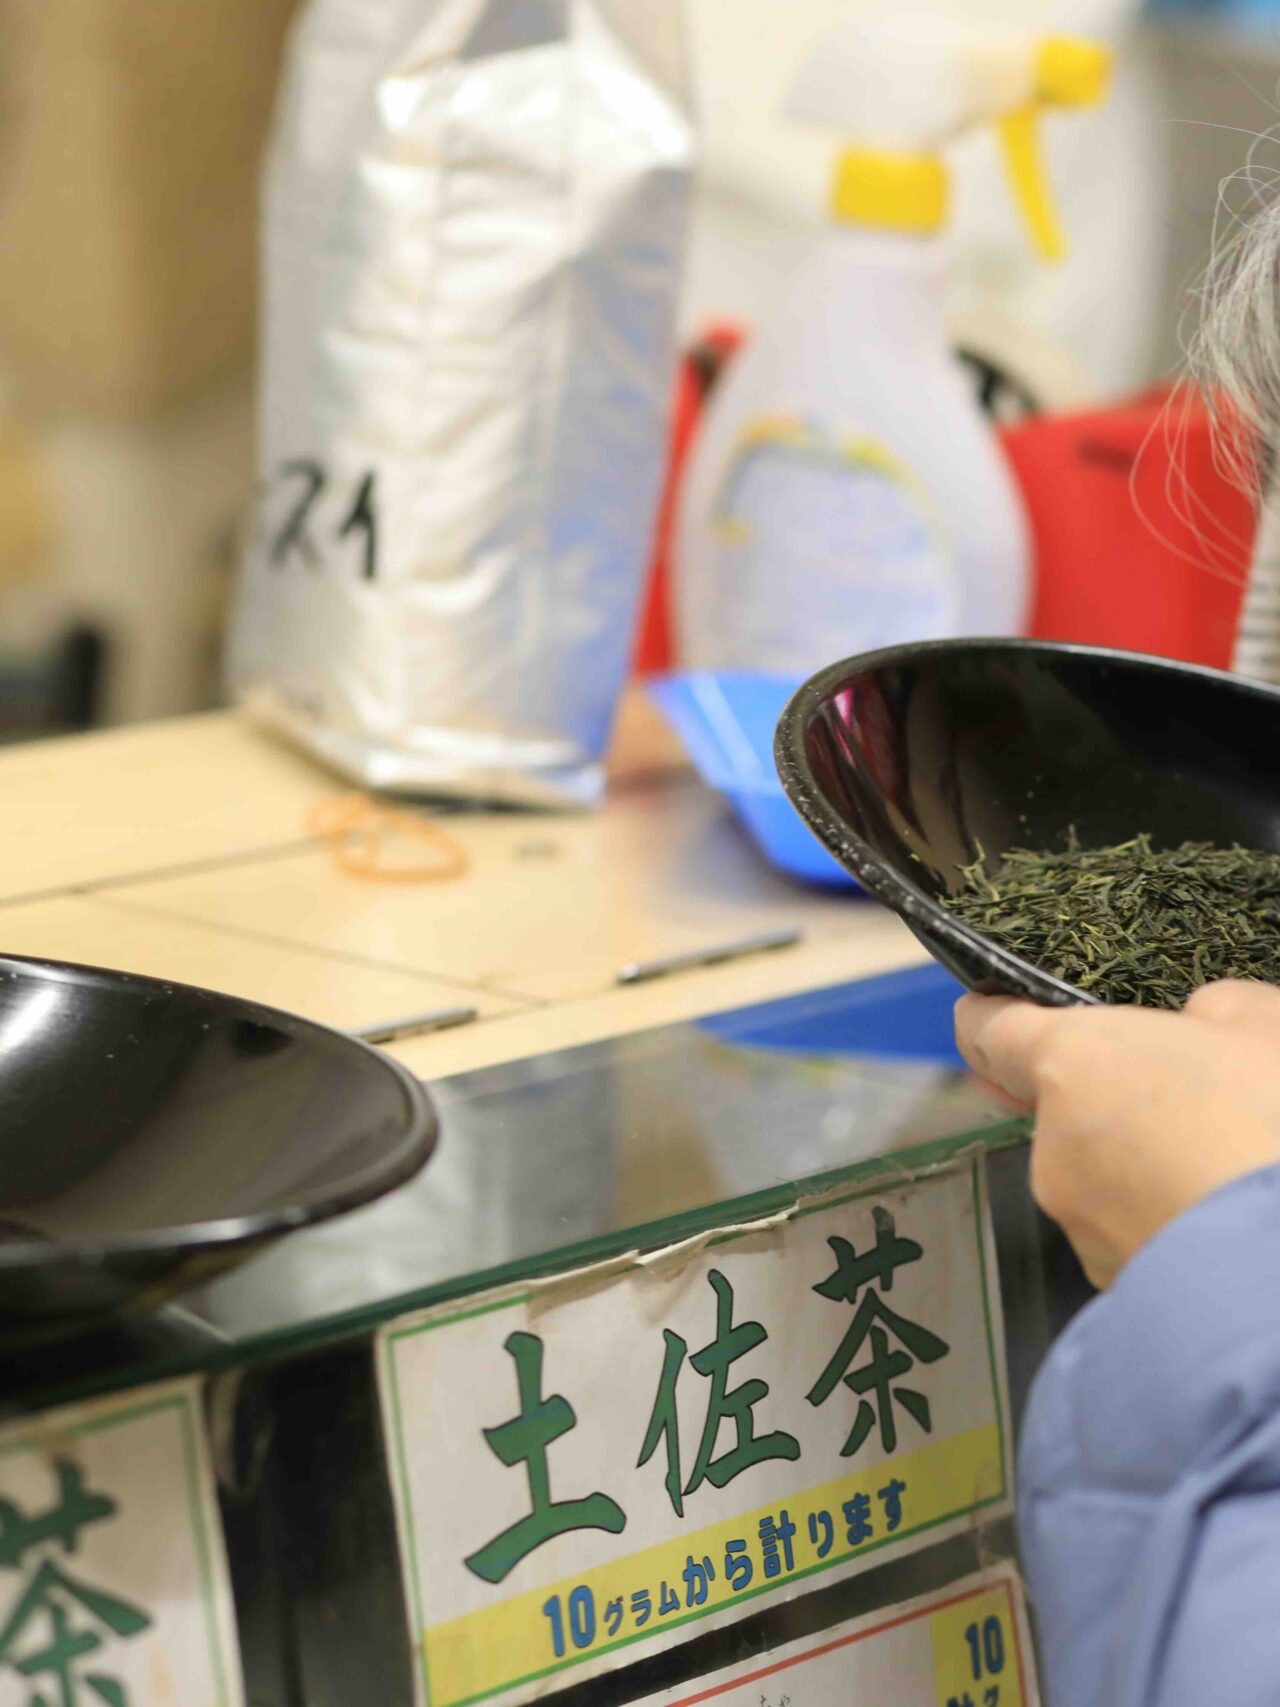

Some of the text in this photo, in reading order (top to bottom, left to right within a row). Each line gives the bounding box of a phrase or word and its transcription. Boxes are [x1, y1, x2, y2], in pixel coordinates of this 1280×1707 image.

[464, 1206, 950, 1584] 土佐茶
[542, 1478, 907, 1658] 10グラムから計ります
